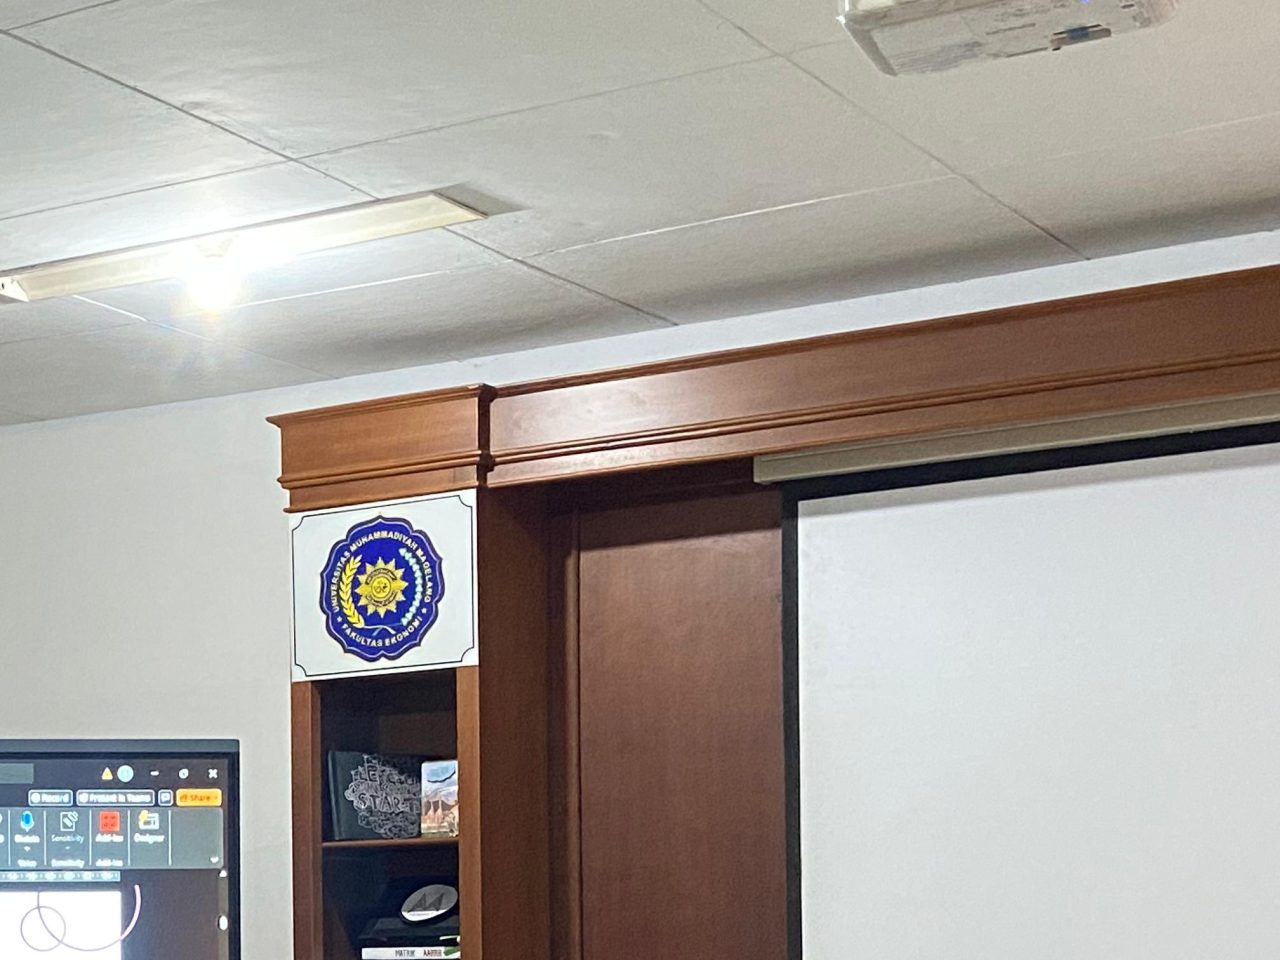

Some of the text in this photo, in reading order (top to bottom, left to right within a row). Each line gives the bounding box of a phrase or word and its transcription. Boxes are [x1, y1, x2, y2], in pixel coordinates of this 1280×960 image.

[330, 530, 433, 613] UNIVERSITAS MUHAMMADIYAH MAGELANG
[341, 615, 423, 647] FAKULTAS EKONOMI
[190, 793, 210, 802] Share
